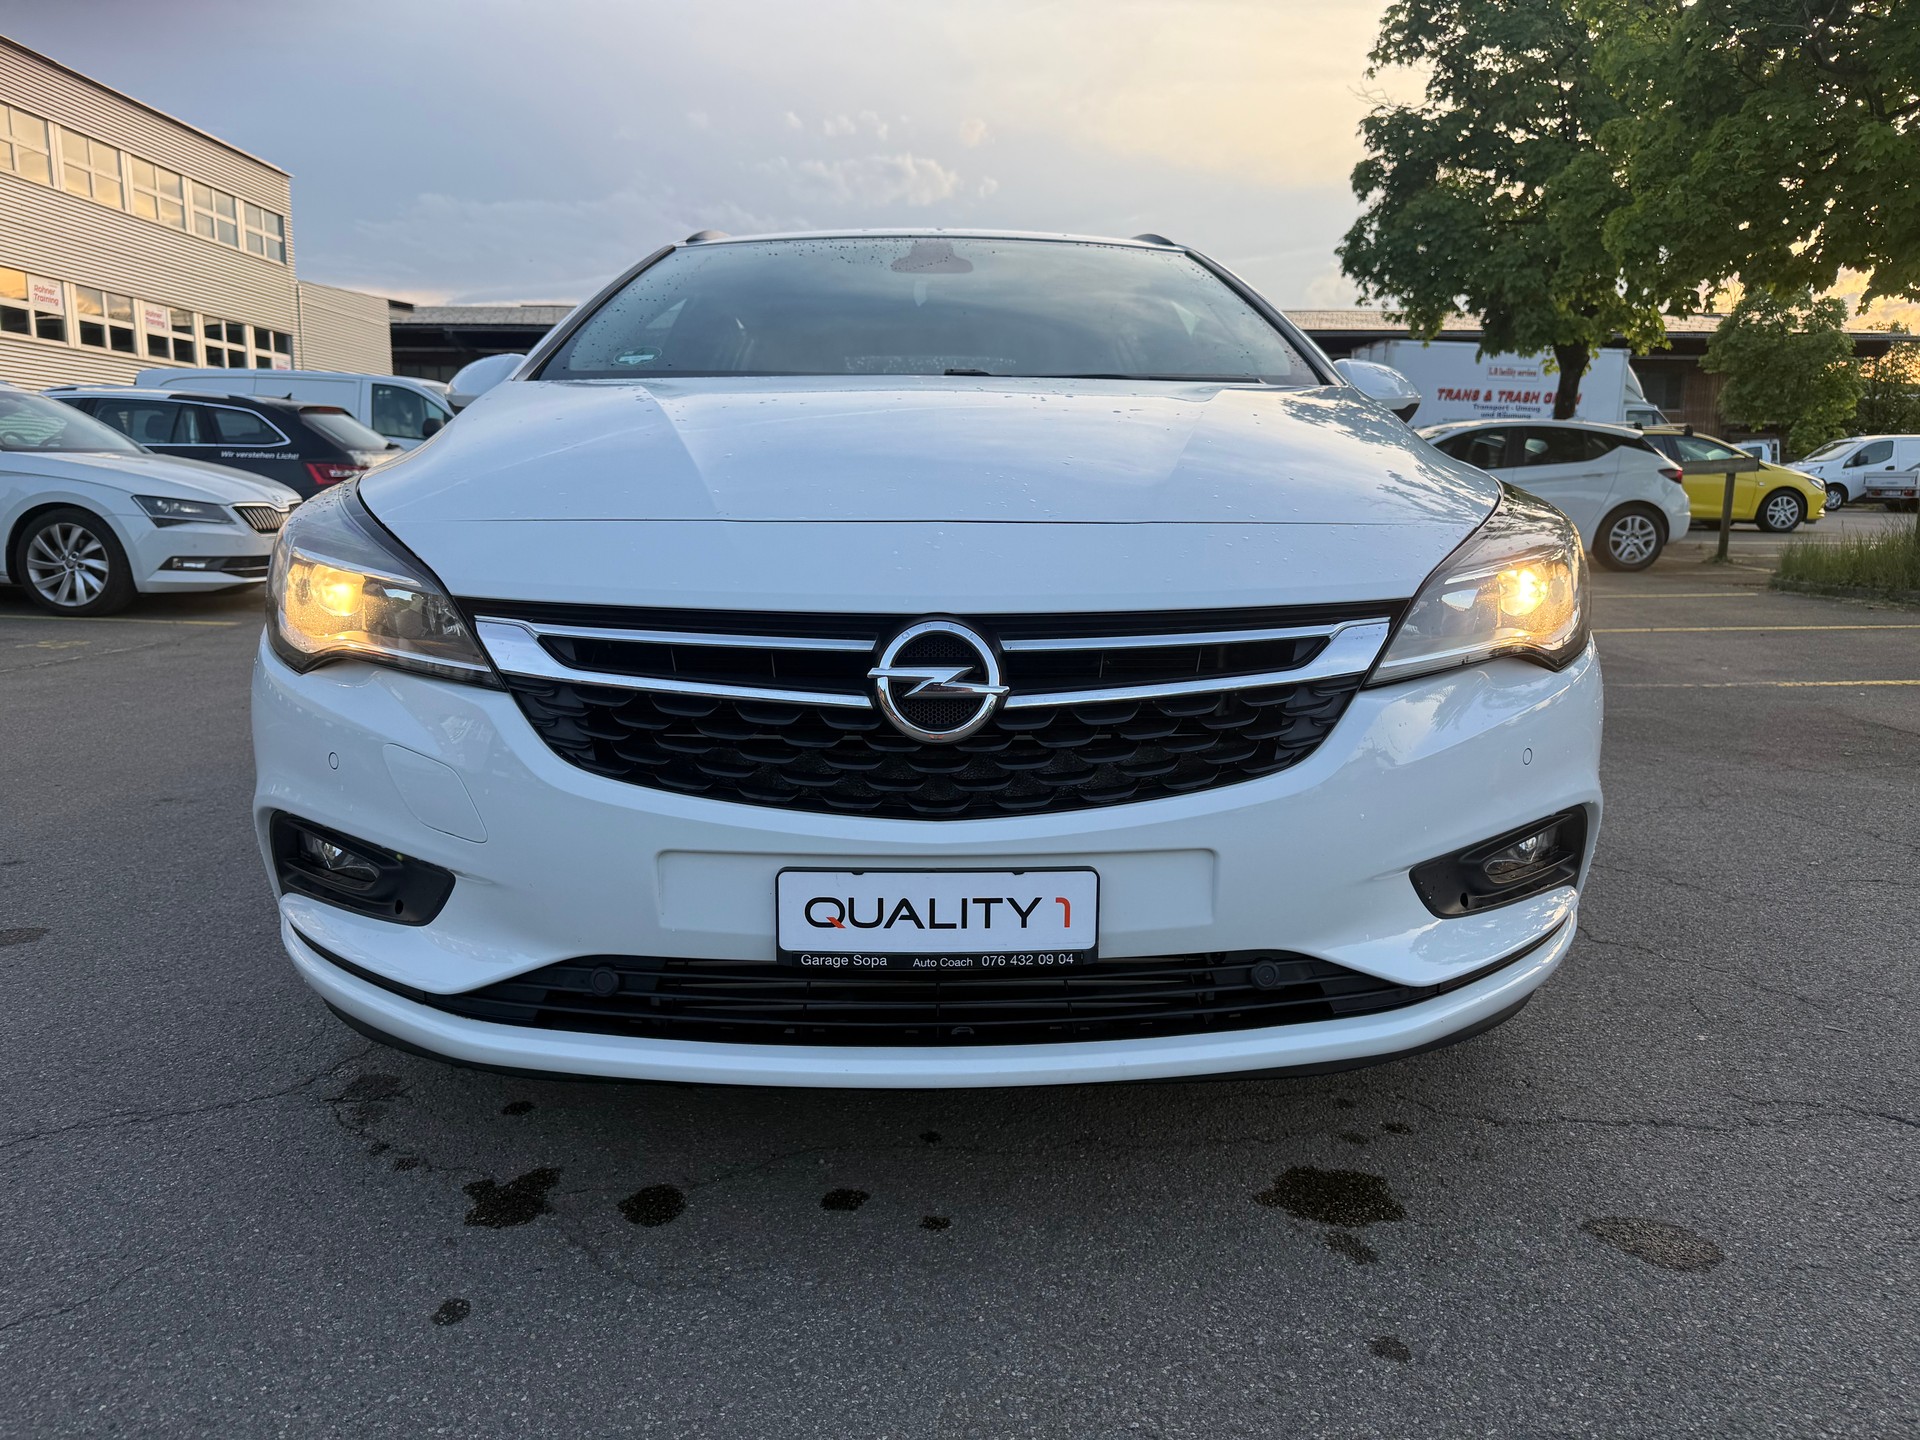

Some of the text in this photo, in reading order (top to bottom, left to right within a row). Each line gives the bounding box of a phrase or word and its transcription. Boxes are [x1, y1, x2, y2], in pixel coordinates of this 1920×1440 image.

[33, 284, 56, 296] Rohner
[33, 292, 59, 306] Training
[1437, 388, 1480, 401] TRANS
[1483, 390, 1493, 402] &
[1497, 390, 1541, 404] TRASH
[1473, 403, 1510, 412] Transport
[1516, 404, 1541, 413] Umzug
[1480, 411, 1495, 419] und
[221, 450, 300, 460] Wir verstehen Licht!
[901, 623, 974, 639] OPEL
[804, 897, 1071, 929] QUALITY 1
[800, 953, 1075, 968] Garage Sopa Auto Coach 076 432 09 04
